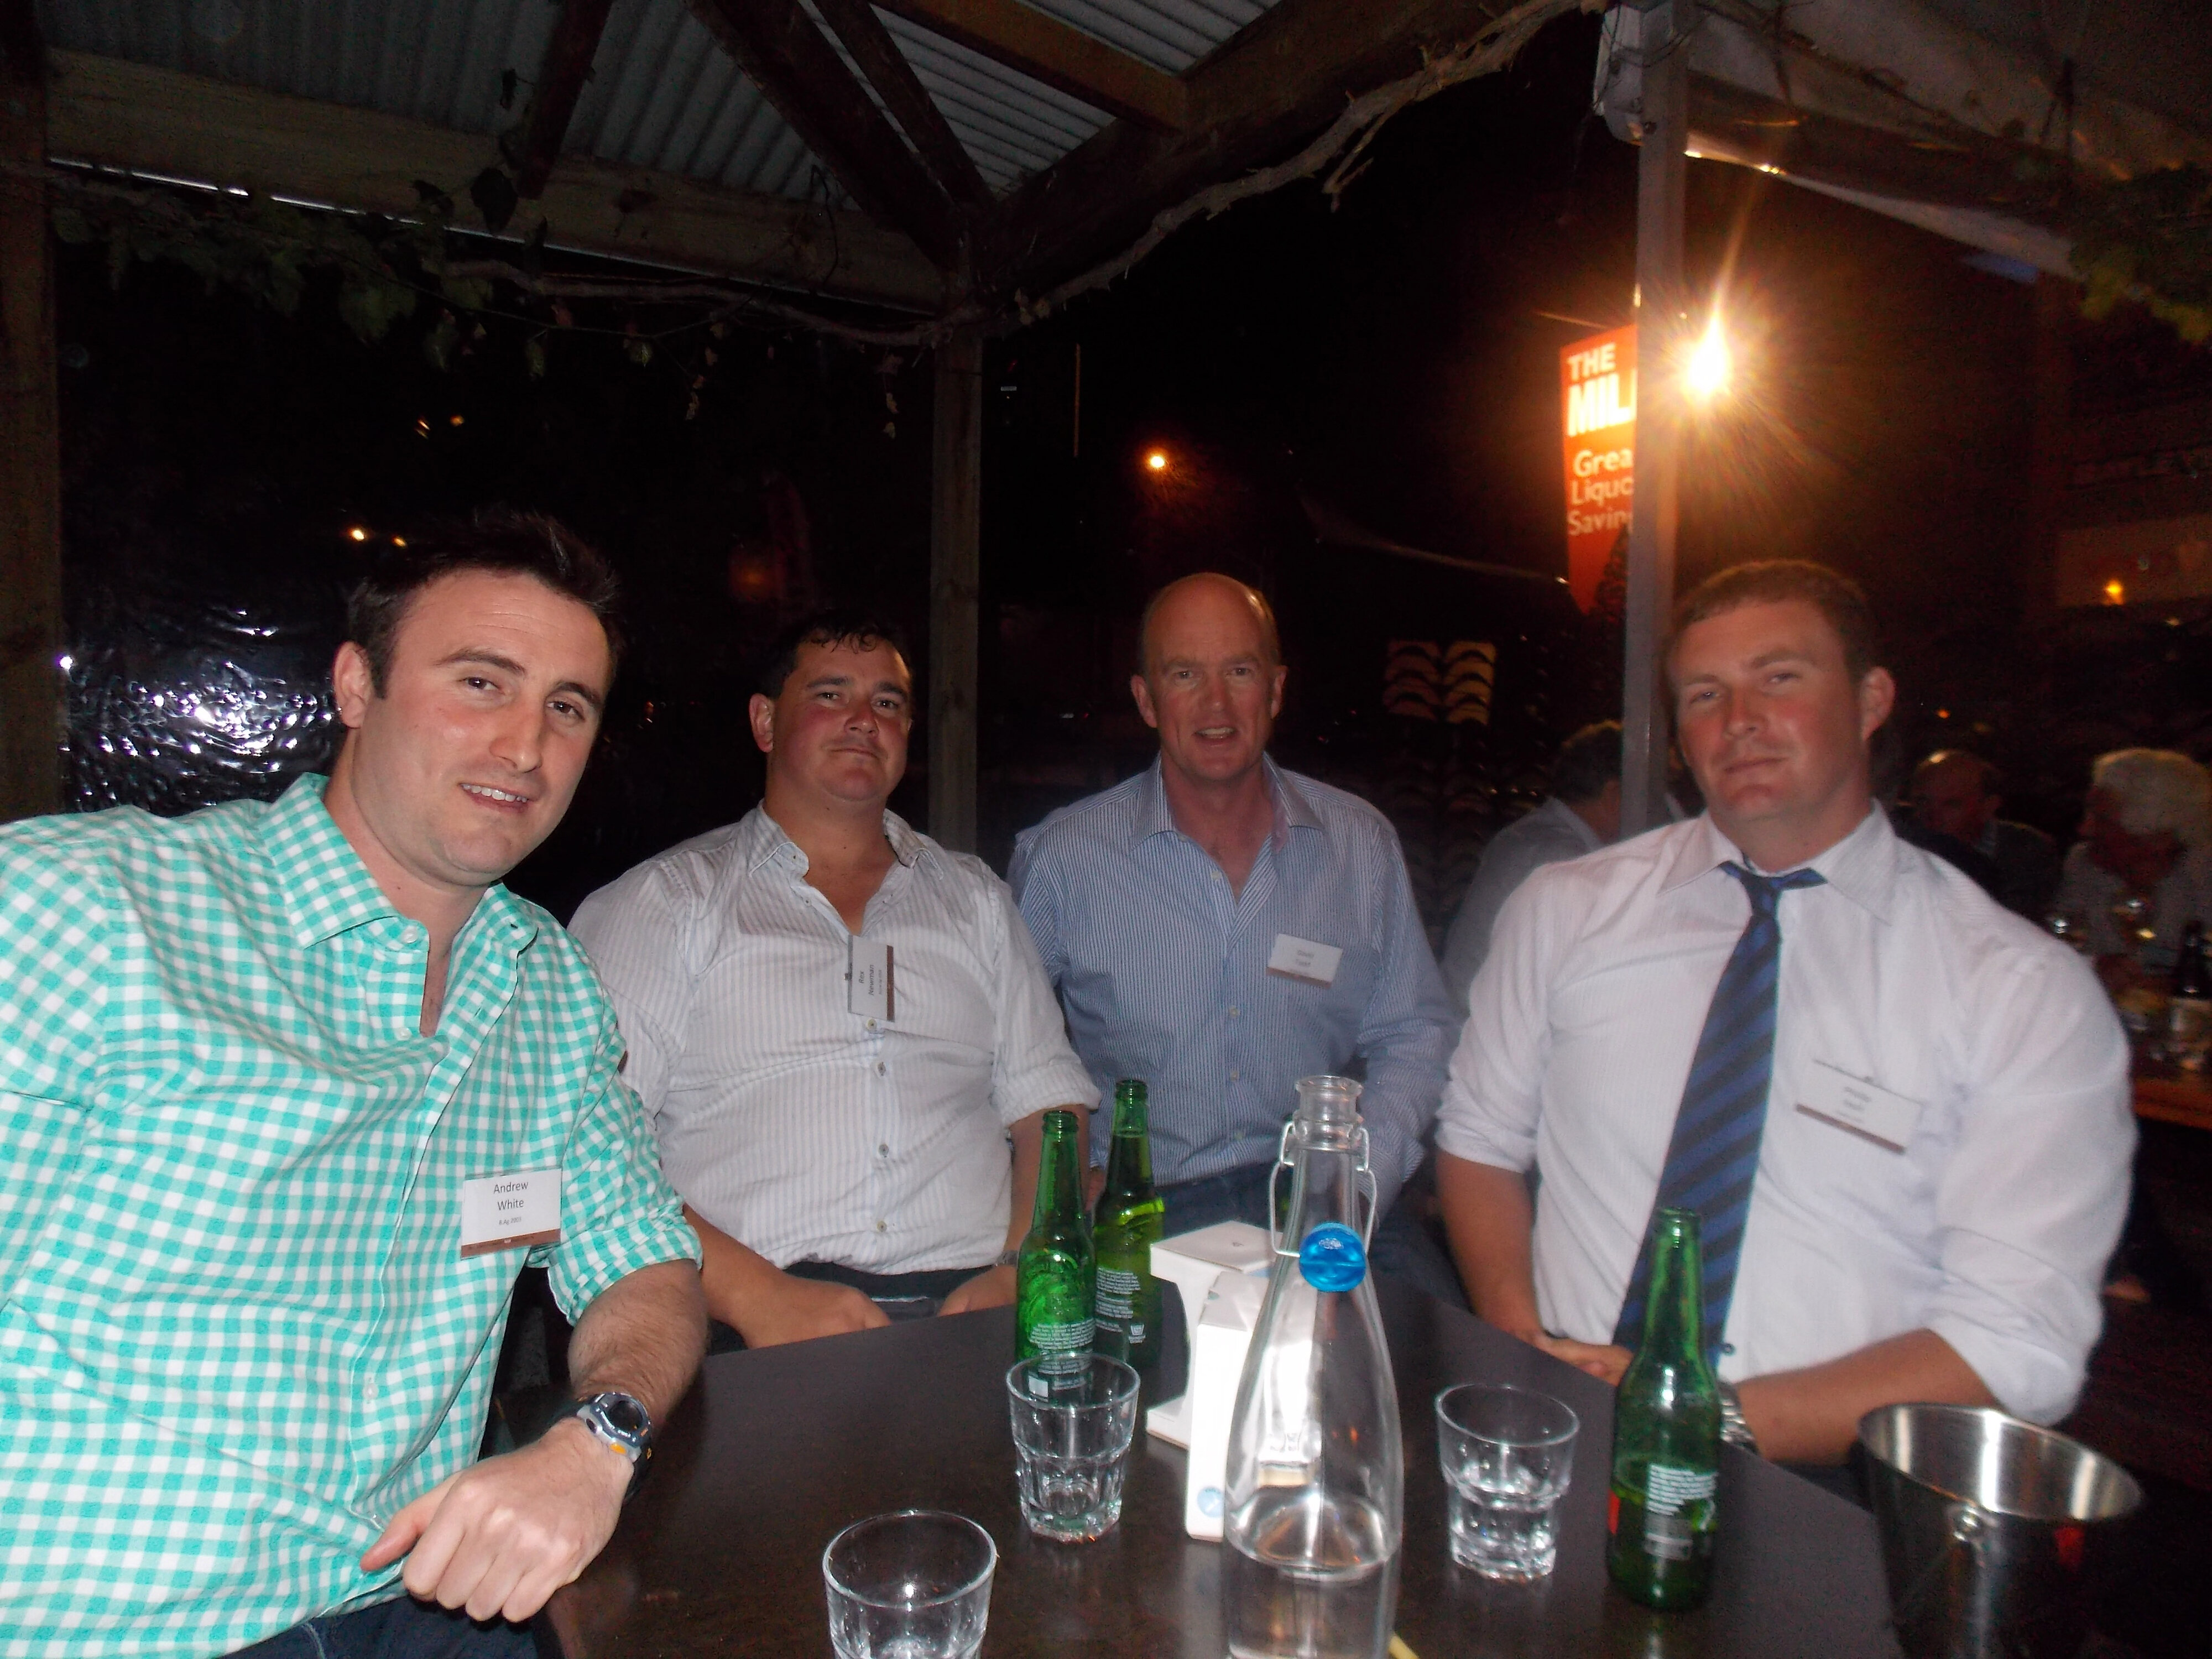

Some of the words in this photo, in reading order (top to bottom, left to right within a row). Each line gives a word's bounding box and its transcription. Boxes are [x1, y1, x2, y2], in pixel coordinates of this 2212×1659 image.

[1568, 343, 1616, 380] THE
[1574, 449, 1632, 477] Grea
[1568, 508, 1632, 535] Savin
[494, 1182, 528, 1193] Andrew
[497, 1199, 524, 1211] White
